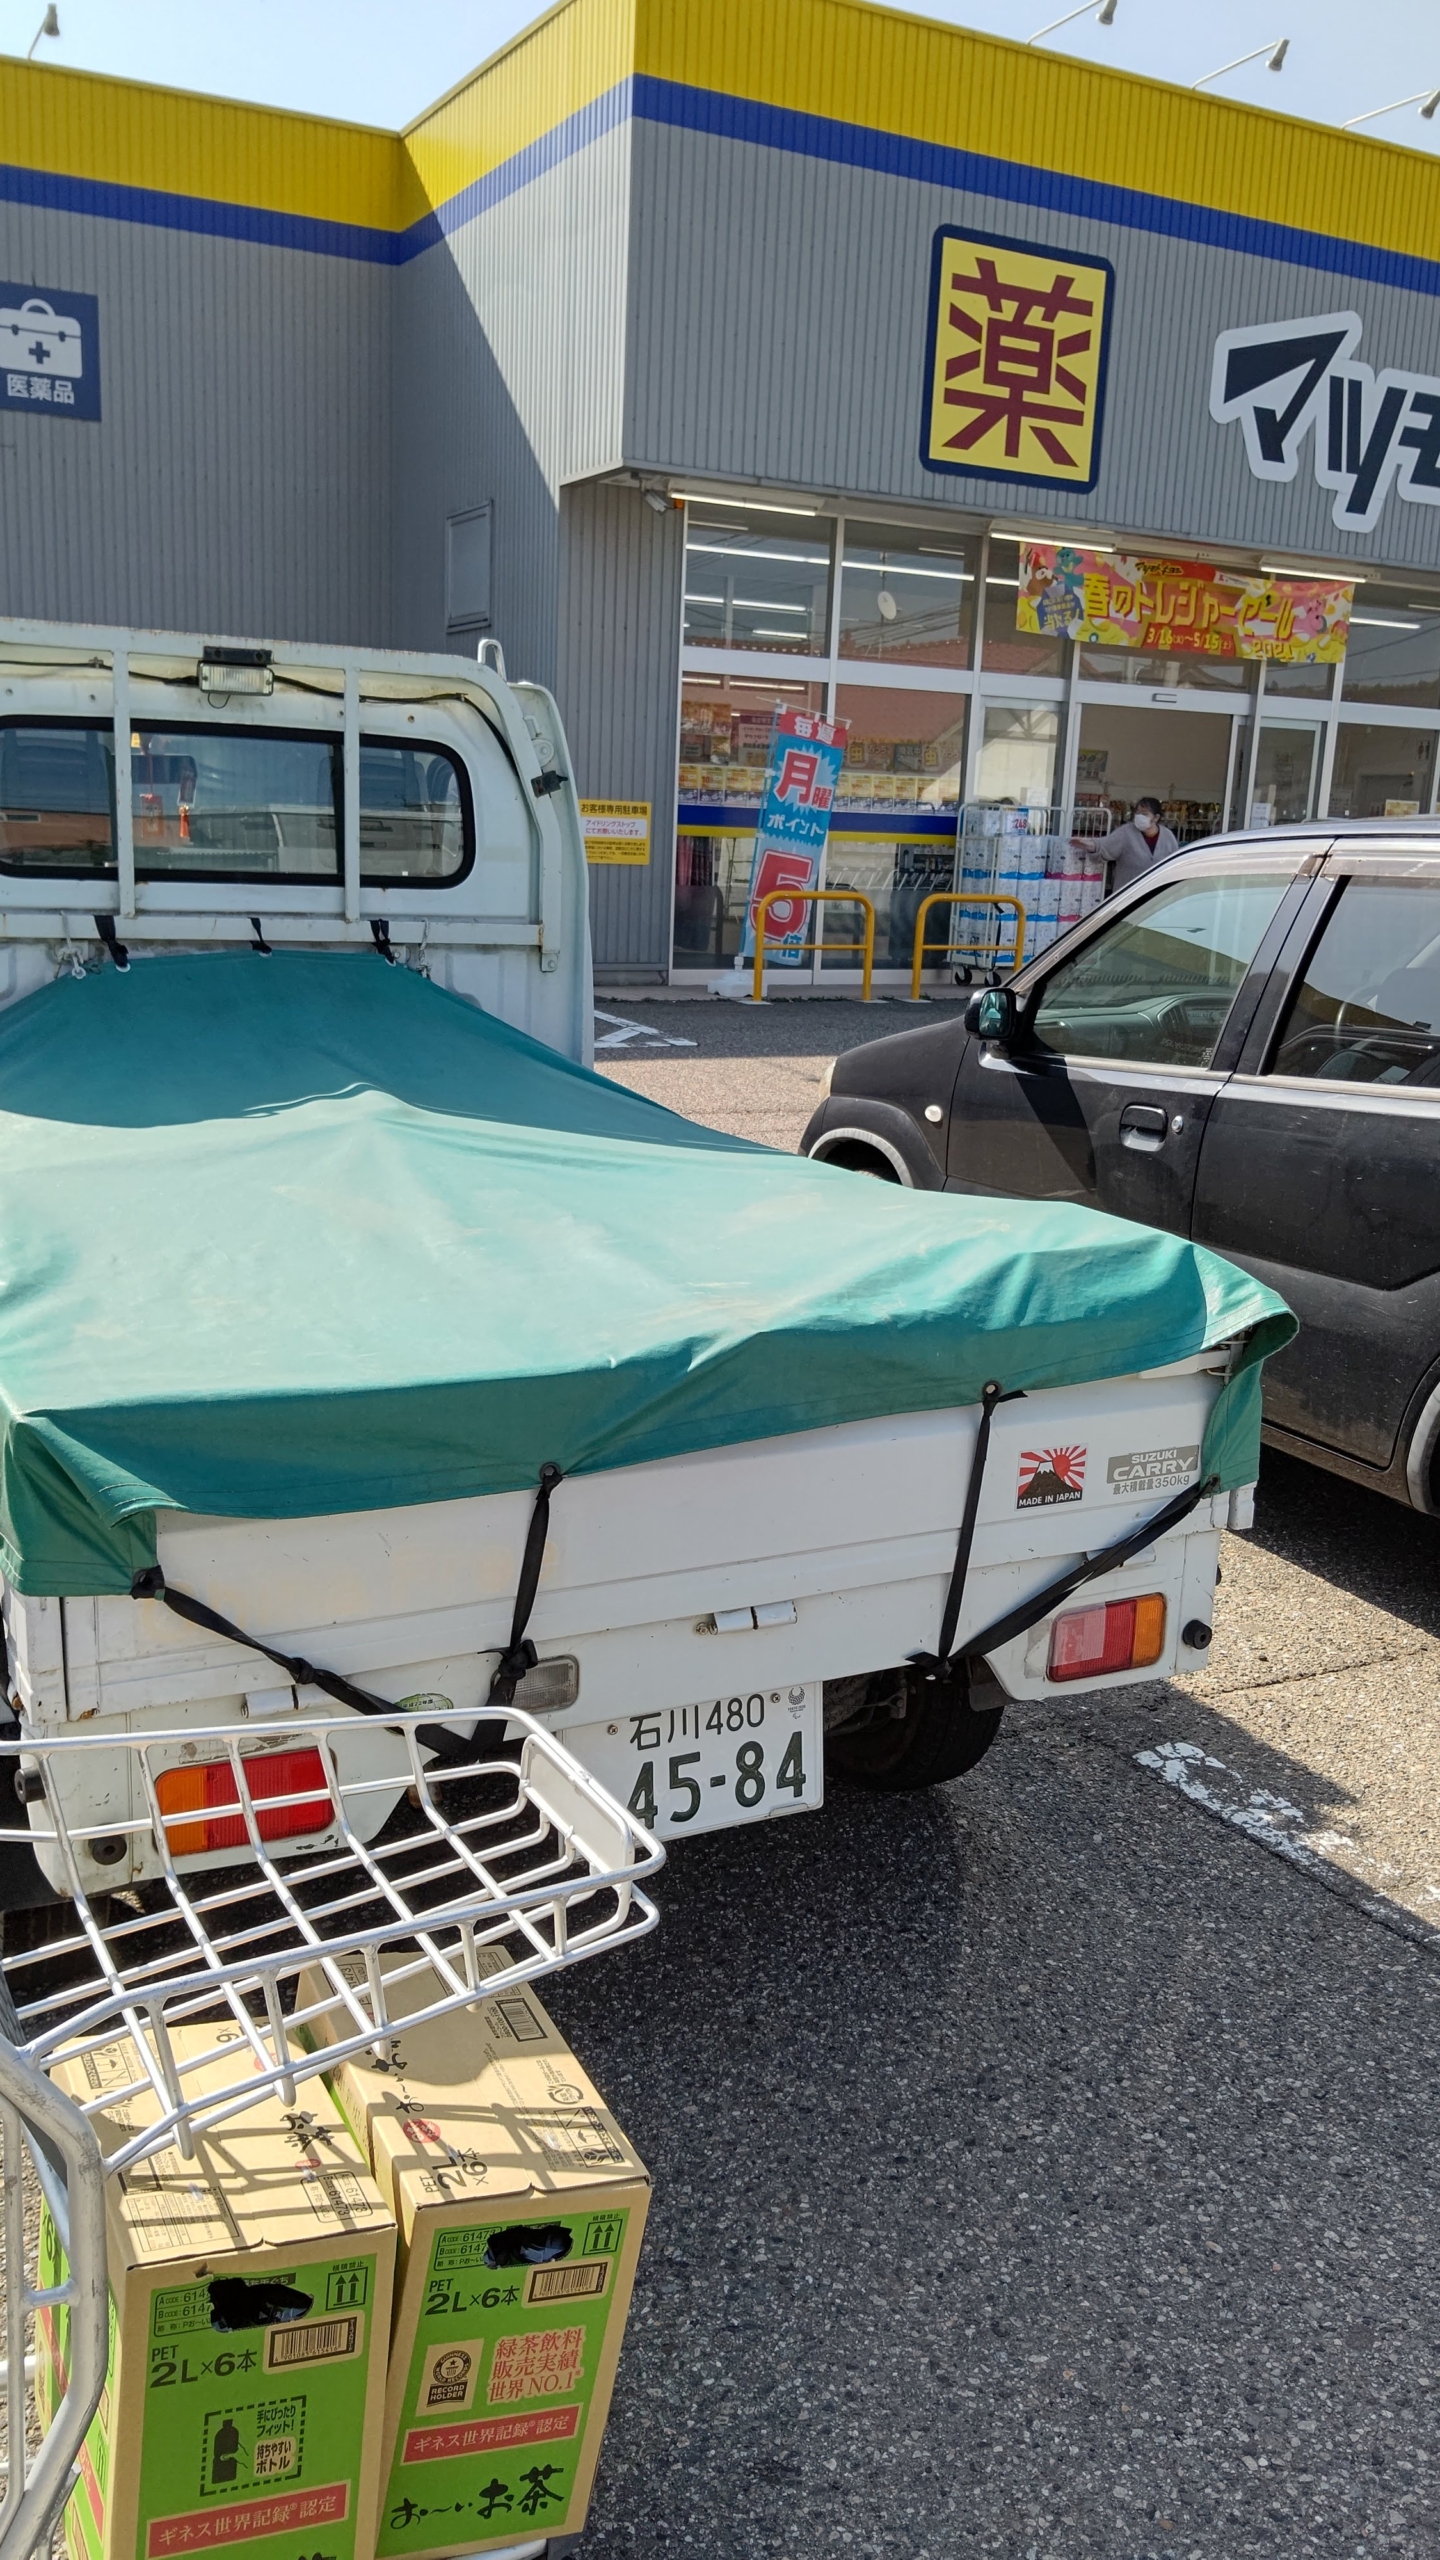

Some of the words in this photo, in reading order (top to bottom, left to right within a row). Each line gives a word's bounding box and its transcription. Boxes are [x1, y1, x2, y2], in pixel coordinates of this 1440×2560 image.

[941, 256, 1094, 468] 薬
[7, 373, 75, 405] 医薬品
[1083, 573, 1296, 641] 春のトレジャーセール
[794, 716, 836, 745] 毎週
[581, 804, 648, 816] お客様専用駐車場
[585, 820, 637, 828] アイドリングストップ
[767, 814, 824, 837] ポイント
[1131, 1449, 1177, 1464] SUZUKI
[1113, 1456, 1195, 1481] CARRY
[1018, 1497, 1042, 1507] MADE
[1045, 1495, 1054, 1503] IN
[1055, 1491, 1081, 1502] JAPAN
[627, 1730, 806, 1830] 45-84
[419, 2175, 441, 2194] PET
[460, 2243, 487, 2254] 6147
[429, 2278, 454, 2293] PET
[151, 2344, 179, 2362] PET
[496, 2327, 582, 2359] 緑茶飲料
[491, 2350, 579, 2381] 販売実績
[430, 2390, 464, 2401] HOLDER
[431, 2384, 465, 2395] RECORD
[256, 2440, 292, 2460] 持ちやすい
[255, 2455, 291, 2475] ボトル
